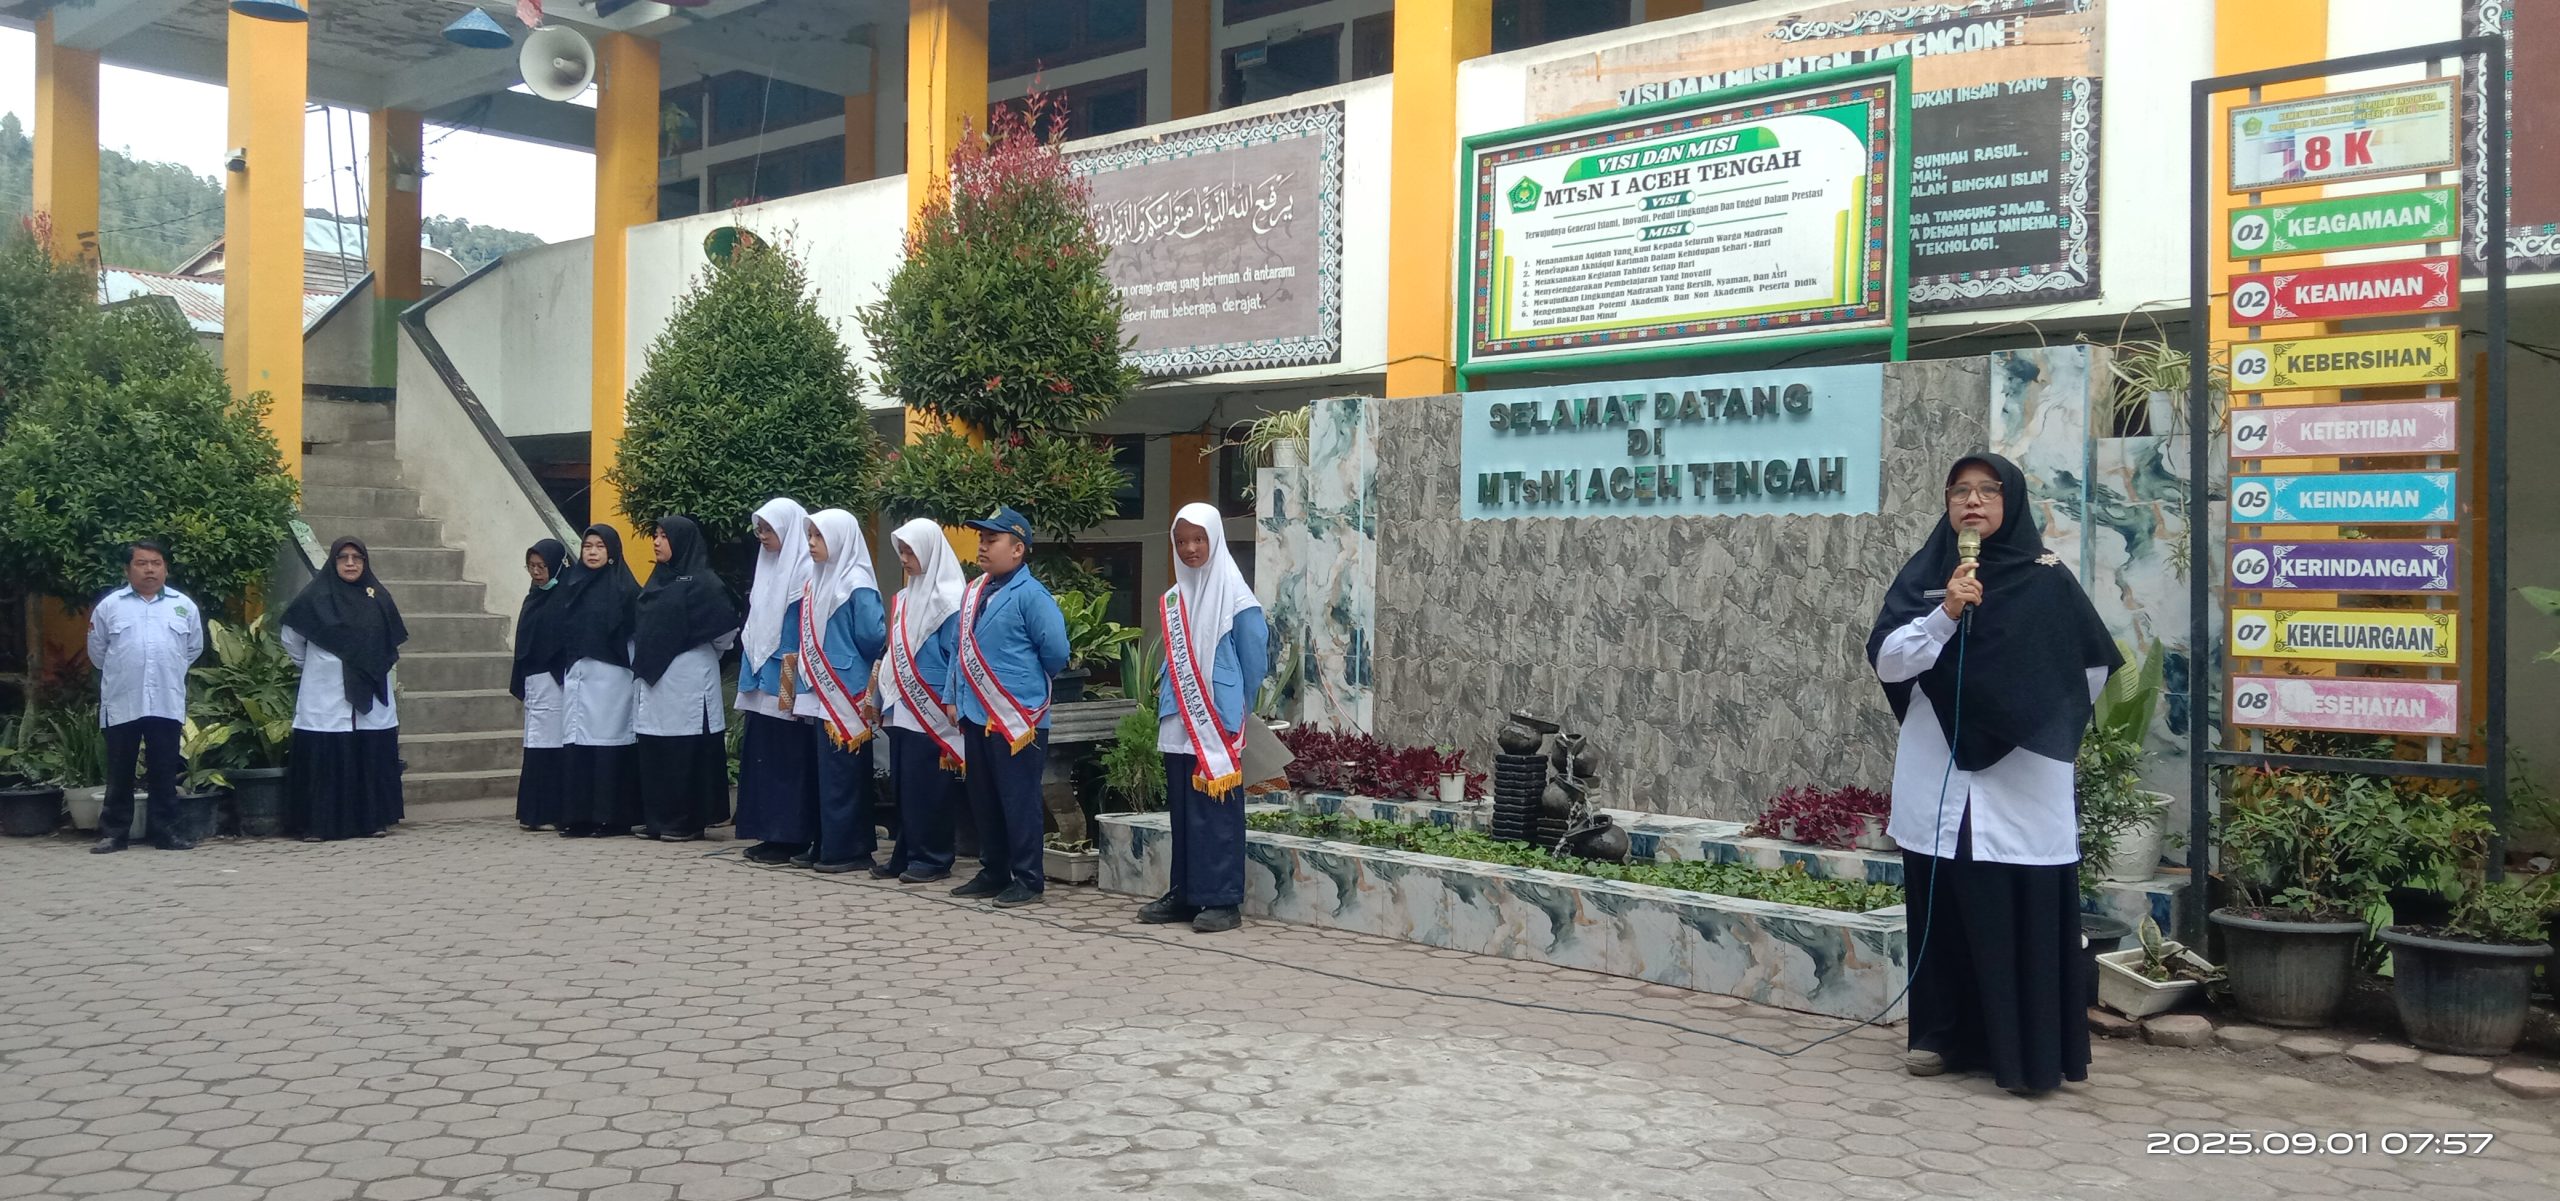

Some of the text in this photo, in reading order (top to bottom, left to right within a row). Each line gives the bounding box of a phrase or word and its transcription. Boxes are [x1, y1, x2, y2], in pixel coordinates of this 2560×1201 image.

[1597, 134, 1741, 174] VISI DAN MISI
[1914, 143, 2029, 170] SUNNAH RASUL.
[2304, 130, 2374, 171] 8 K
[1544, 182, 1604, 207] MTsN
[1626, 168, 1691, 195] ACEH
[1697, 150, 1802, 183] TENGAH
[1952, 174, 2008, 194] BINGKAI
[2011, 169, 2049, 187] ISLAM
[1567, 222, 1596, 234] Generasi
[1653, 210, 1675, 222] Peduli
[1677, 203, 1719, 219] Lingkungan
[1720, 201, 1735, 212] Dan
[1764, 193, 1790, 205] Dalam
[1791, 188, 1824, 201] Prestasi
[1650, 194, 1682, 207] VISI
[1932, 200, 2051, 223] TANGGUNG JAWAB.
[1647, 226, 1682, 239] MISI
[1922, 223, 1969, 241] DENGAN
[1971, 220, 1998, 236] BAIK
[1998, 217, 2020, 233] DAN
[2021, 214, 2059, 232] BENAR
[2236, 204, 2432, 243] 01 KEAGAMAAN
[1536, 253, 1584, 267] Menanamkan
[1585, 250, 1612, 260] Aqidah
[1613, 247, 1633, 257] Yang
[1653, 240, 1683, 252] Kepada
[1684, 236, 1715, 247] Seluruh
[1716, 232, 1742, 243] Warga
[1743, 226, 1783, 238] Madrasah
[1616, 255, 1649, 267] Karimah
[1650, 251, 1676, 261] Dalam
[1677, 246, 1721, 258] Kehidupan
[1722, 241, 1748, 253] Sehari
[1753, 238, 1771, 248] Hari
[1915, 237, 2000, 257] TEKNOLOGI.
[1130, 280, 1178, 296] orang-orang
[1180, 277, 1200, 292] yang
[1202, 271, 1240, 287] beriman
[1242, 266, 1252, 282] di
[1254, 265, 1296, 281] antaramu
[1587, 269, 1622, 281] Kegiatan
[1677, 259, 1695, 270] Hari
[1604, 276, 1658, 289] Pembelajaran
[1659, 272, 1680, 282] Yang
[1680, 268, 1712, 280] Inovatif
[1533, 294, 1579, 307] Mewujudkan
[1580, 289, 1625, 302] Lingkungan
[1626, 285, 1664, 297] Madrasah
[1665, 281, 1685, 292] Yang
[1753, 272, 1770, 282] Dan
[1770, 269, 1788, 279] Asri
[1533, 303, 1595, 317] Mengembangkan
[1598, 300, 1627, 311] Potensi
[1630, 295, 1670, 307] Akademik
[1673, 293, 1690, 302] Dan
[1693, 291, 1710, 300] Non
[1713, 285, 1755, 298] Akademik
[1759, 281, 1790, 293] Peserta
[1794, 277, 1818, 288] Didik
[2236, 276, 2424, 309] 02 KEAMANAN
[1149, 303, 1169, 320] ilmu
[1172, 301, 1217, 319] beberapa
[1222, 293, 1267, 315] derajat.
[1532, 317, 1556, 328] Sesuai
[1556, 314, 1579, 324] Bakat
[1579, 312, 1596, 322] Dan
[2236, 346, 2432, 376] 03 KEBERSIHAN
[1489, 383, 1814, 431] SELAMAT DATANG
[1627, 427, 1667, 458] DI
[2236, 418, 2418, 442] 04 KETERTIBAN
[1585, 464, 1684, 501] ACEH
[1687, 456, 1848, 498] TENGAH
[2236, 490, 2420, 509] 05 KEINDAHAN
[2235, 557, 2439, 578] 06 KERINDANGAN
[2236, 623, 2435, 652] 07 KEKELUARGAAN
[1171, 608, 1209, 727] PROTOKOL UPACARA
[908, 674, 929, 705] SISWA
[2236, 692, 2427, 719] 08 ESEHATAN
